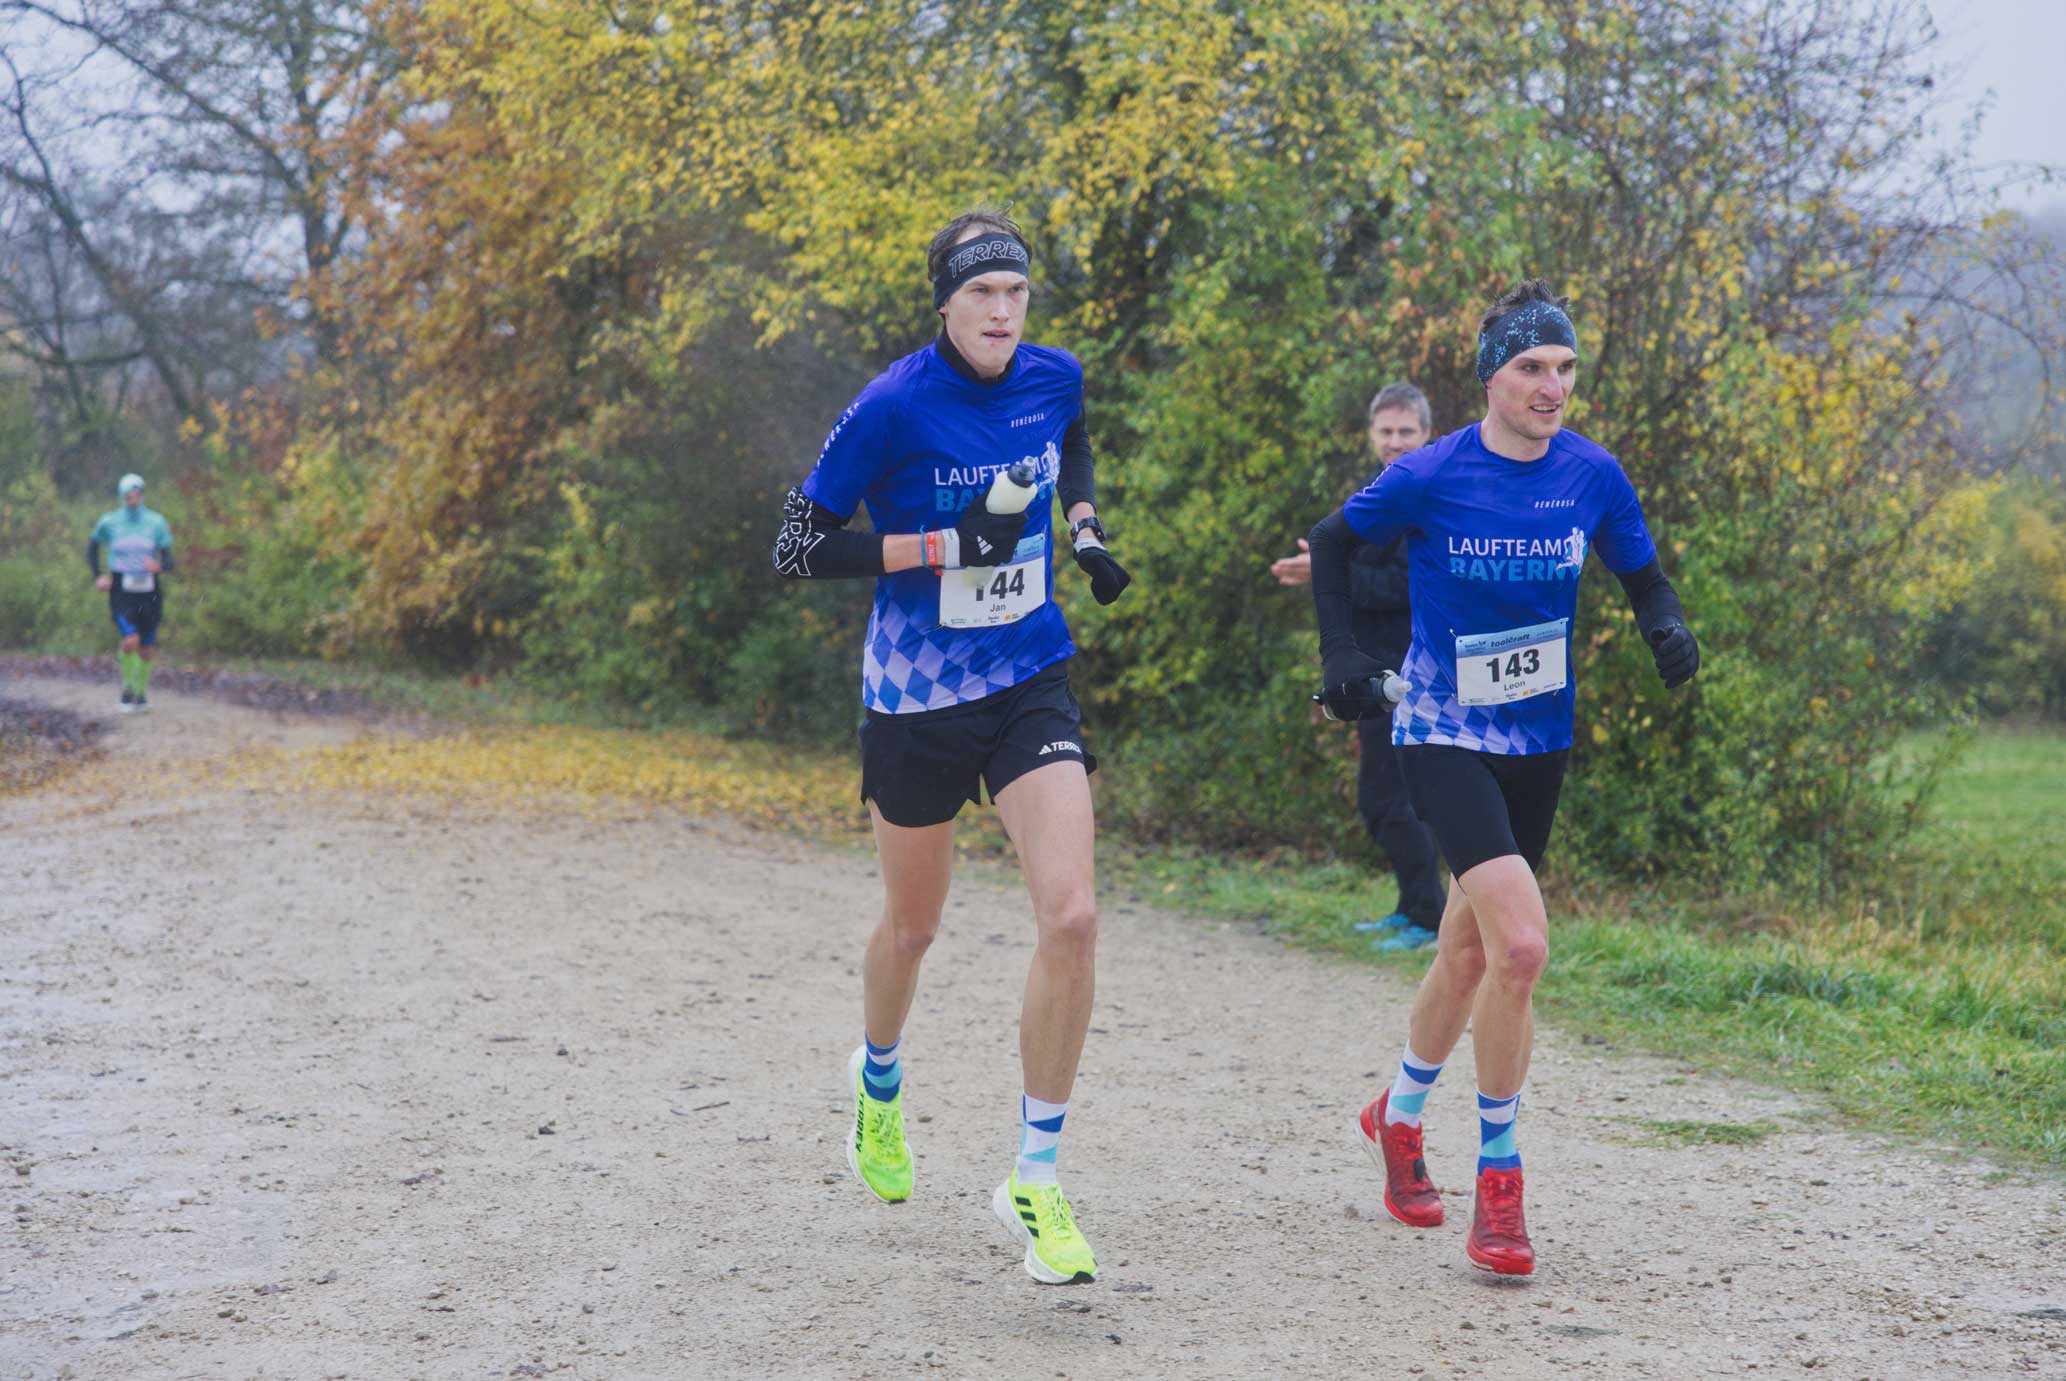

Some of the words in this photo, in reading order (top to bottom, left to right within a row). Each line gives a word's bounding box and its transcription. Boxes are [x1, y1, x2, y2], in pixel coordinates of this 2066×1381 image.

[934, 456, 1042, 486] LAUFTM
[1448, 536, 1562, 557] LAUFTEAM
[1449, 556, 1567, 582] BAYERN
[989, 603, 1006, 613] Jan
[1486, 648, 1540, 683] 143
[1503, 681, 1526, 692] Leon
